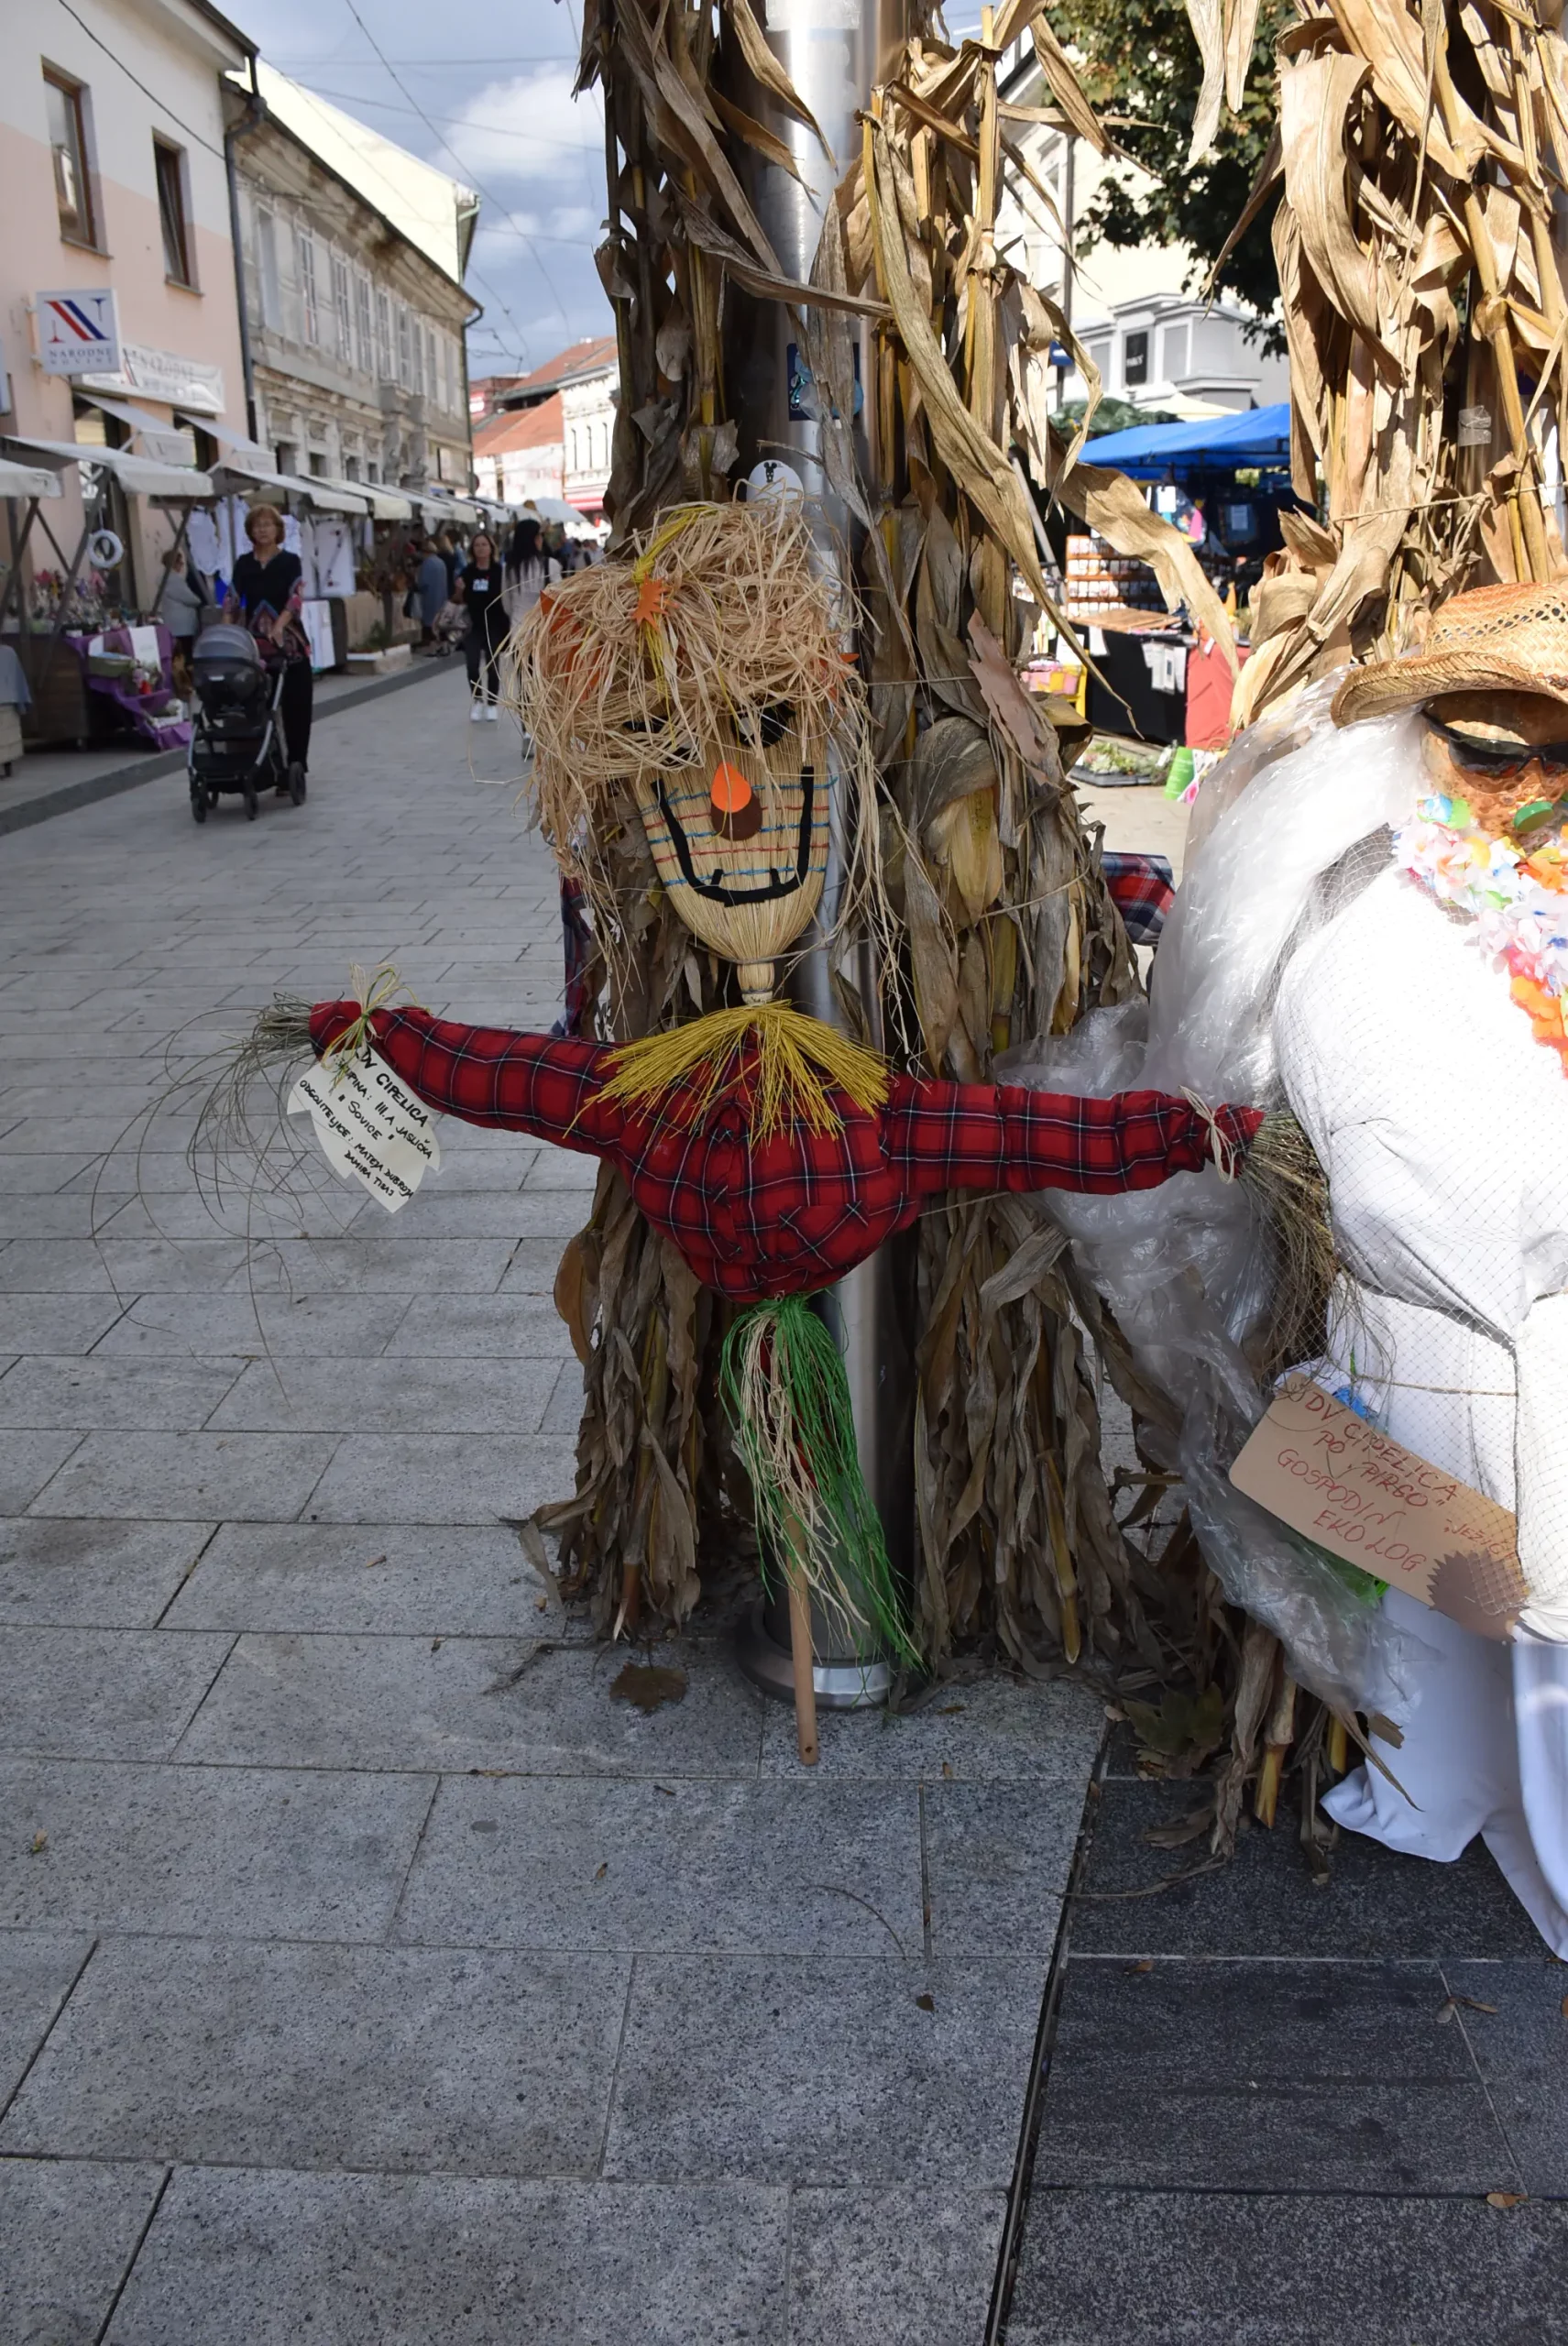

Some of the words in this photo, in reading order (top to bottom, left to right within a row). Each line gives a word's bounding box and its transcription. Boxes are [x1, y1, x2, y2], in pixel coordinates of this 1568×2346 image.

[49, 348, 111, 357] NARODNE
[376, 1072, 429, 1128] CIPELICA
[354, 1143, 384, 1171] MATEJA
[395, 1126, 433, 1159] JASLIČKA
[344, 1150, 371, 1178] DAMIRA
[1305, 1391, 1347, 1421] DV
[1343, 1423, 1457, 1501] CIPELICA
[1313, 1431, 1345, 1453] PO
[1277, 1448, 1407, 1526] GOSPODIN
